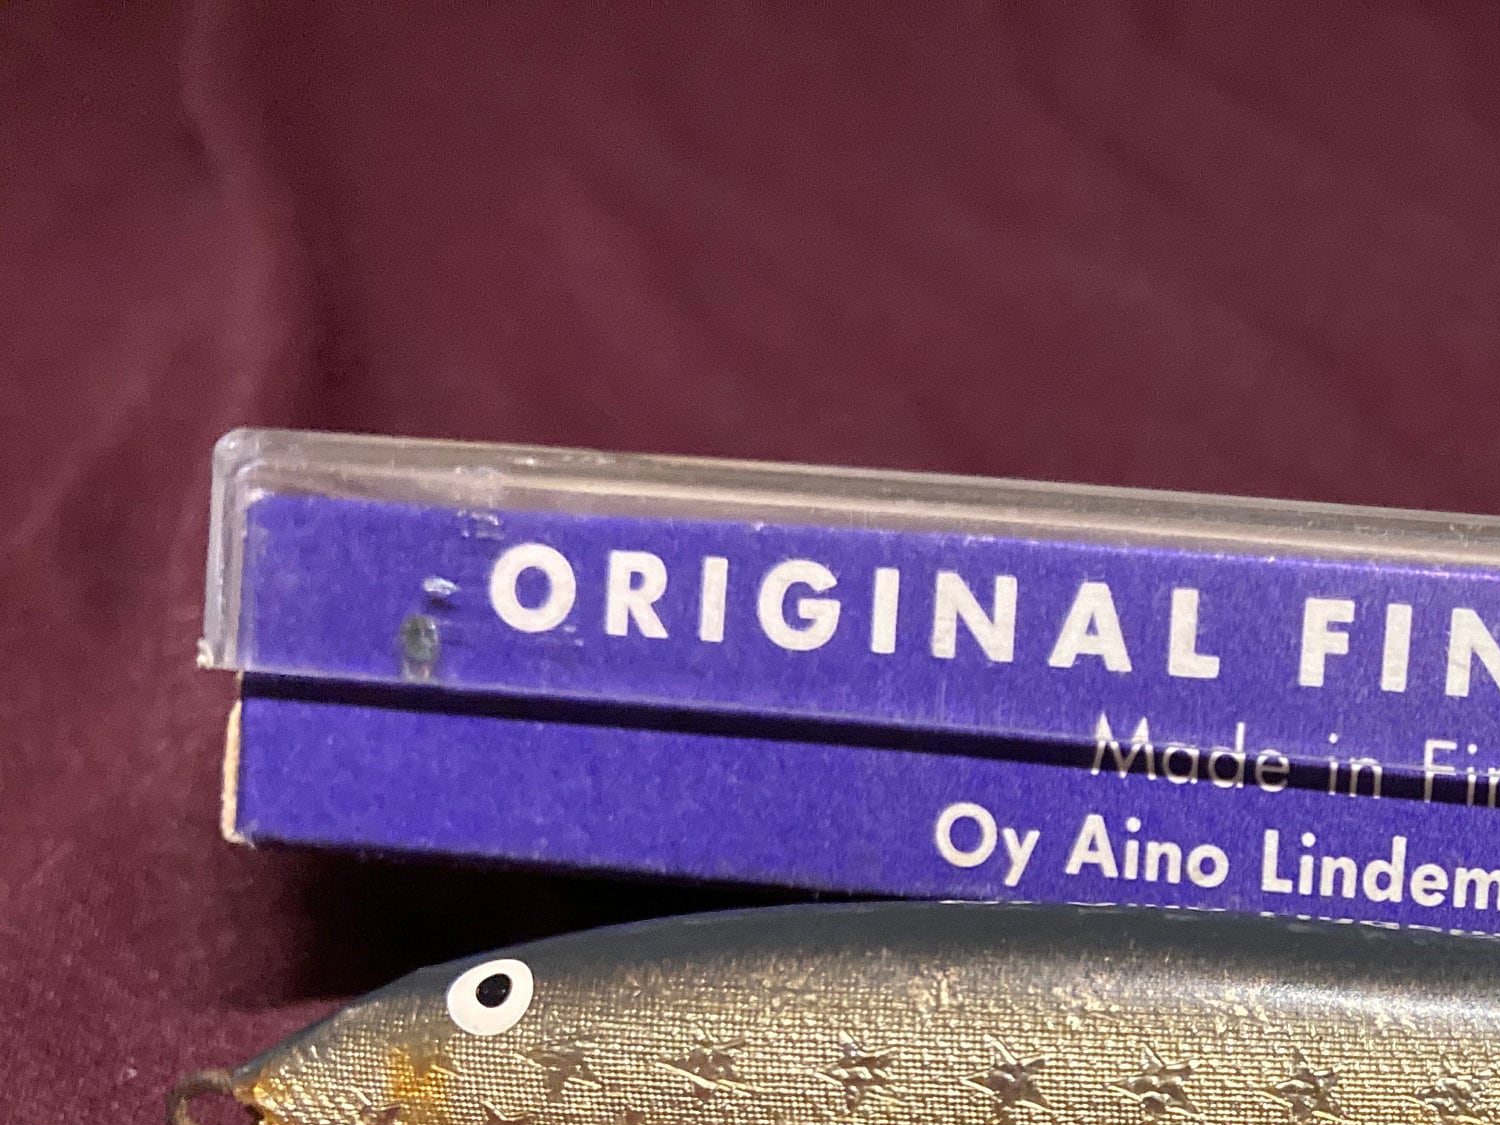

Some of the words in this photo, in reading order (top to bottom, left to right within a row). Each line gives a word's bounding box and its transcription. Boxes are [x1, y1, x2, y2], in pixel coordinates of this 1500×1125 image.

[488, 542, 1221, 680] ORIGINAL
[1091, 713, 1291, 794] Made
[1328, 733, 1384, 800] in
[934, 802, 1039, 887] Oy
[1064, 814, 1230, 889] Aino
